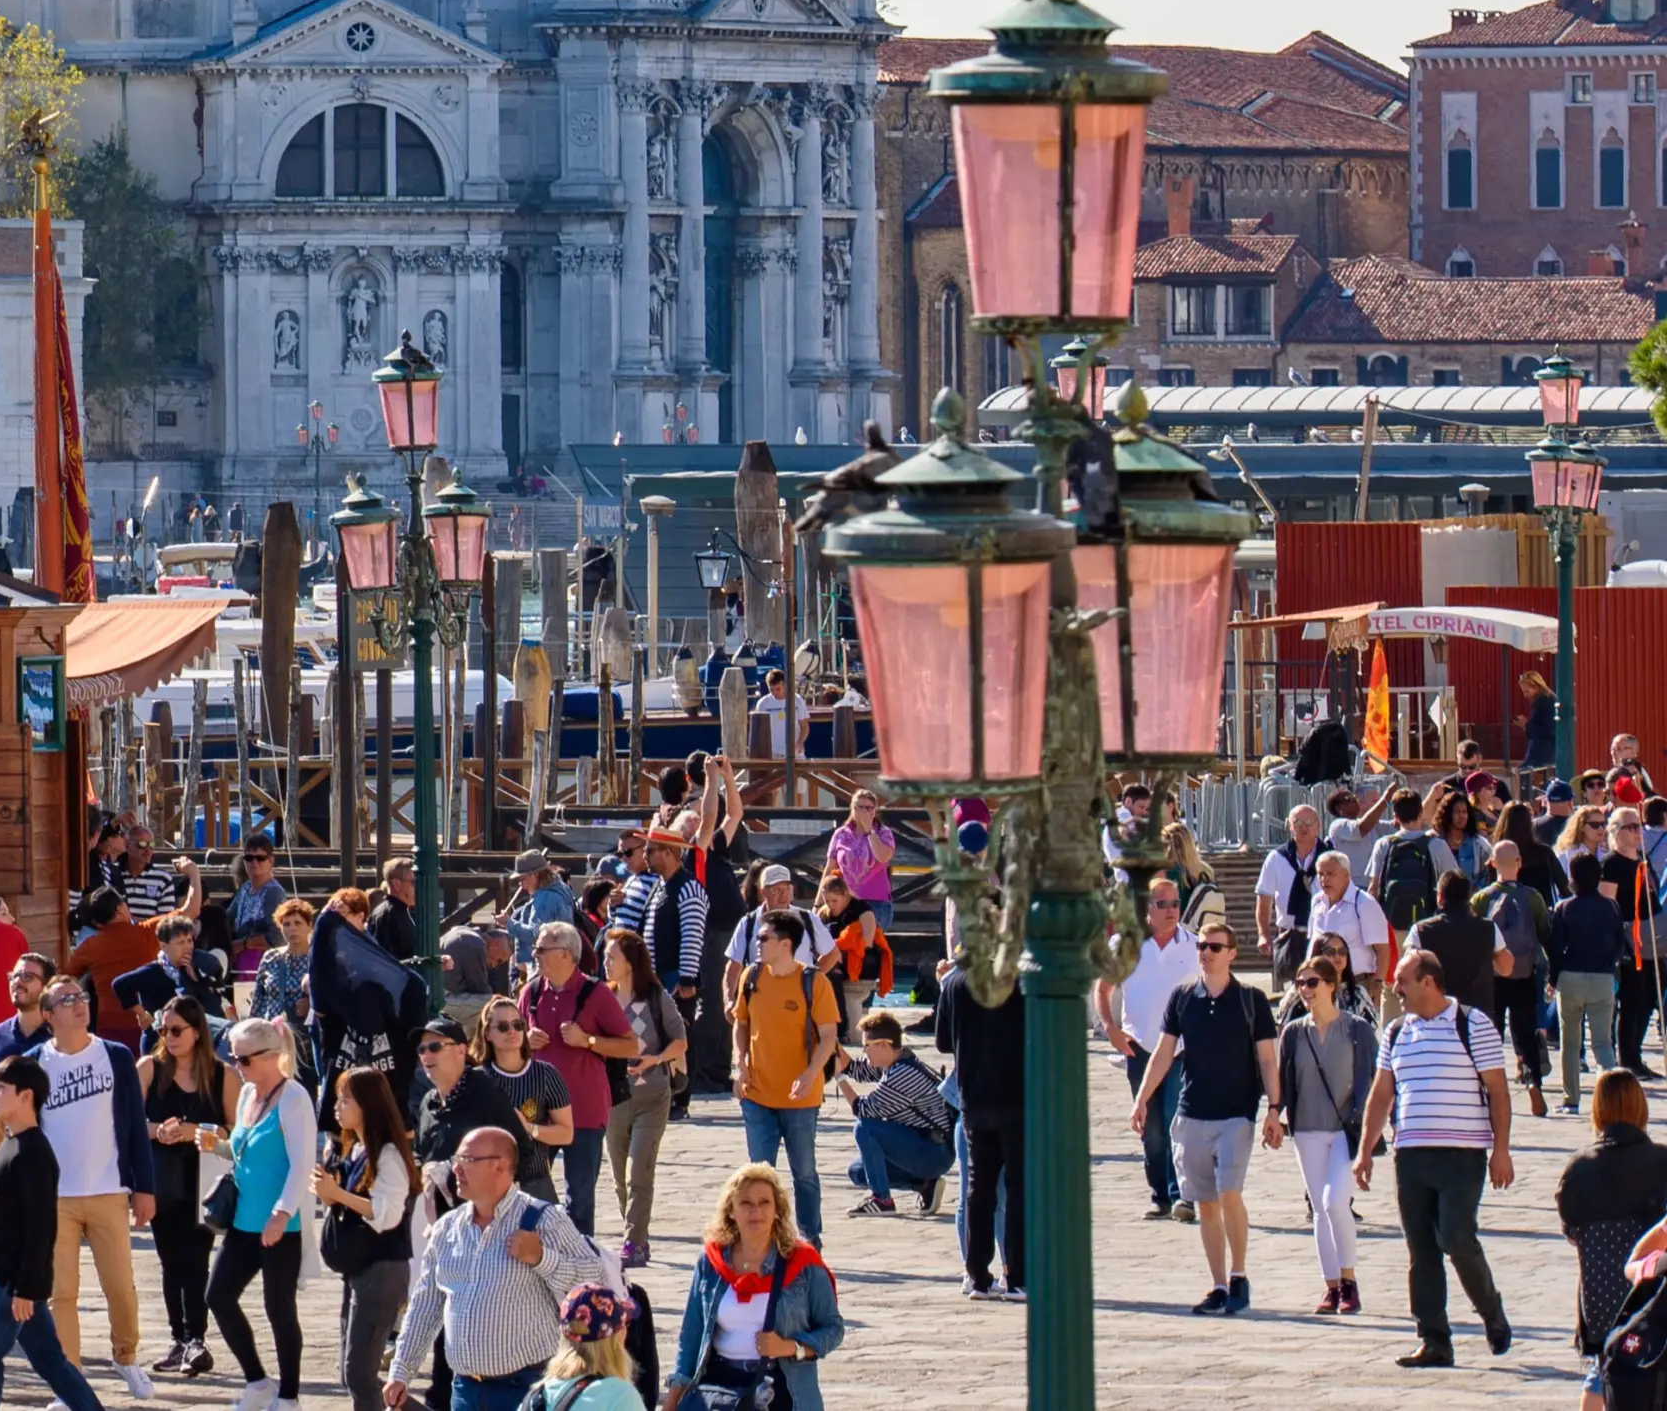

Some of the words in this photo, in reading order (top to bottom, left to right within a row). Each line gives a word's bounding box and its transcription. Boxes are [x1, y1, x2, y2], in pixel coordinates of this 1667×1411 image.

[584, 505, 597, 528] SAN
[1413, 615, 1496, 639] CIPRIANI
[58, 1064, 93, 1089] BLUE
[45, 1073, 113, 1110] IGHTNING
